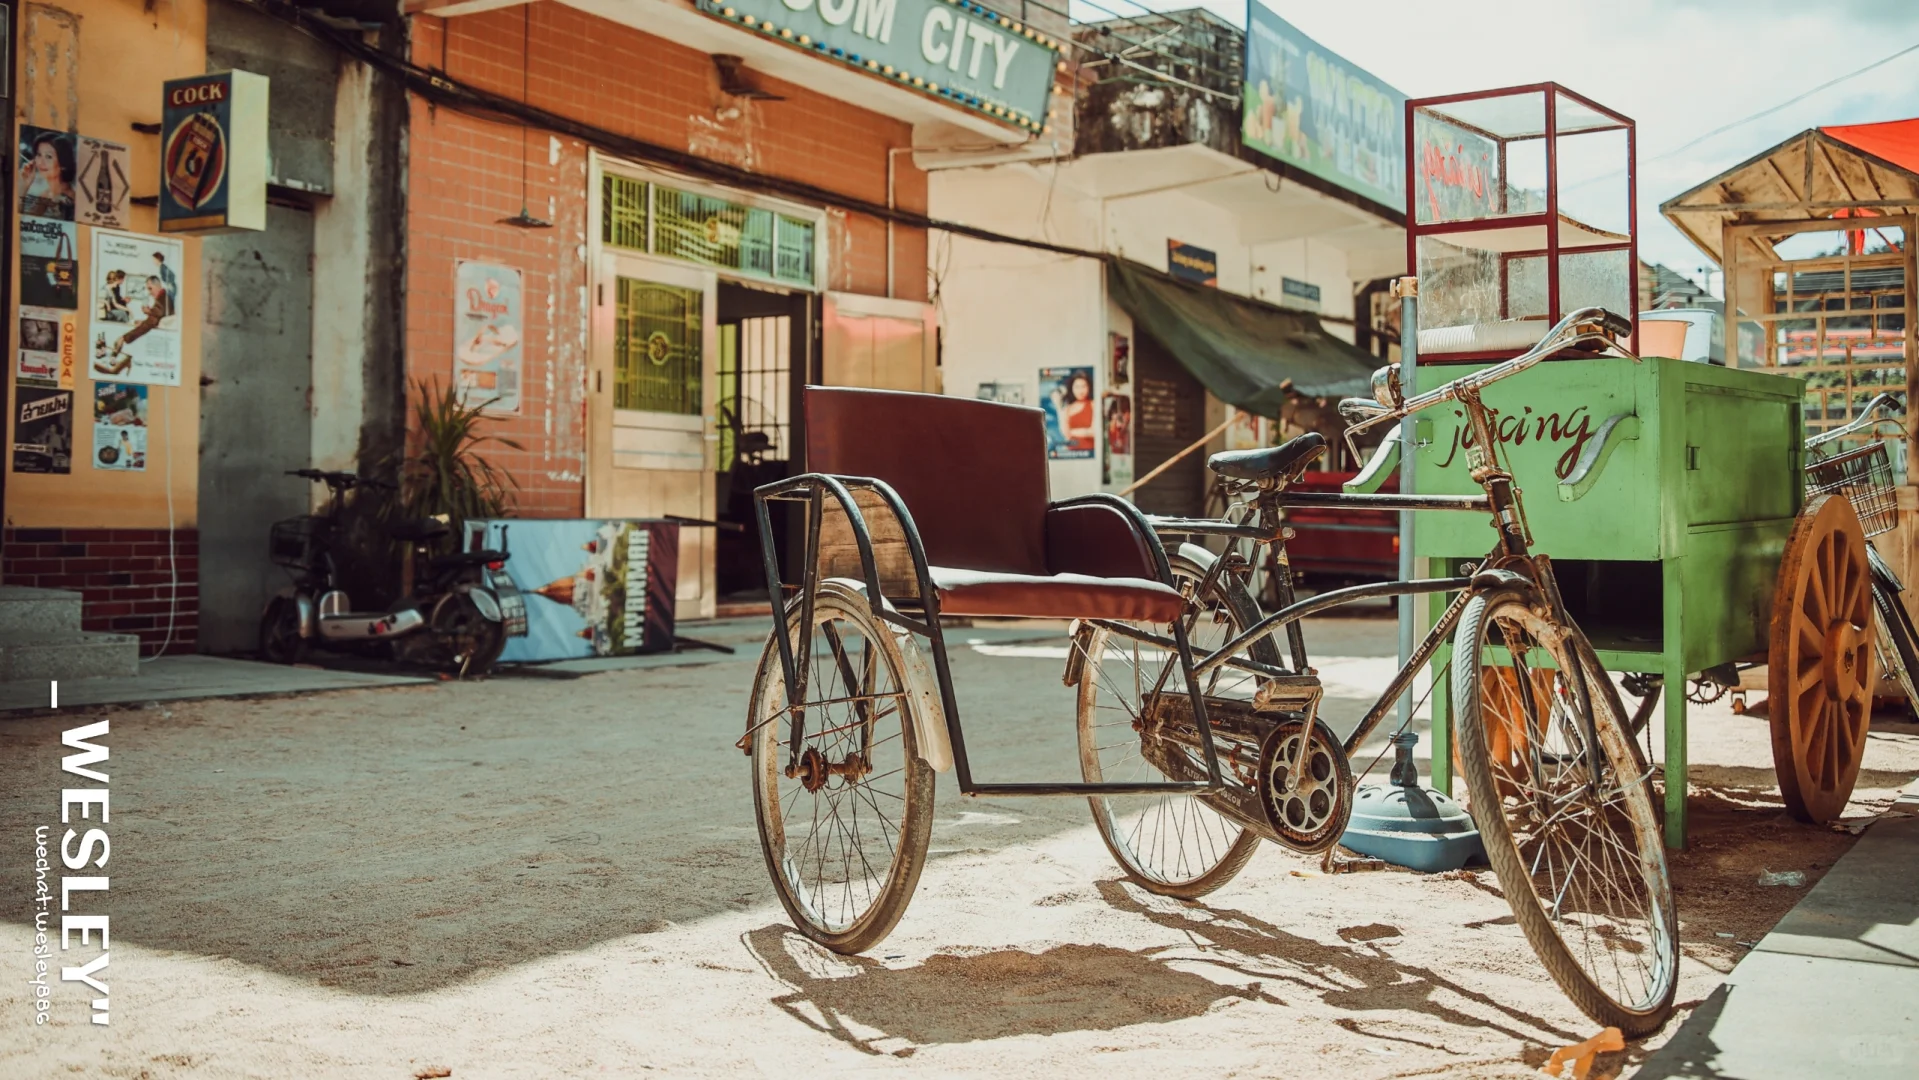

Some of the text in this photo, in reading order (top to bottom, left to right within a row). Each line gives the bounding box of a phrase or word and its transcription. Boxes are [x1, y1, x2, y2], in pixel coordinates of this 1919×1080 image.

[920, 6, 1020, 89] CITY
[172, 83, 223, 105] COCK
[62, 322, 74, 378] OMEGA
[623, 529, 650, 647] MYANMAR
